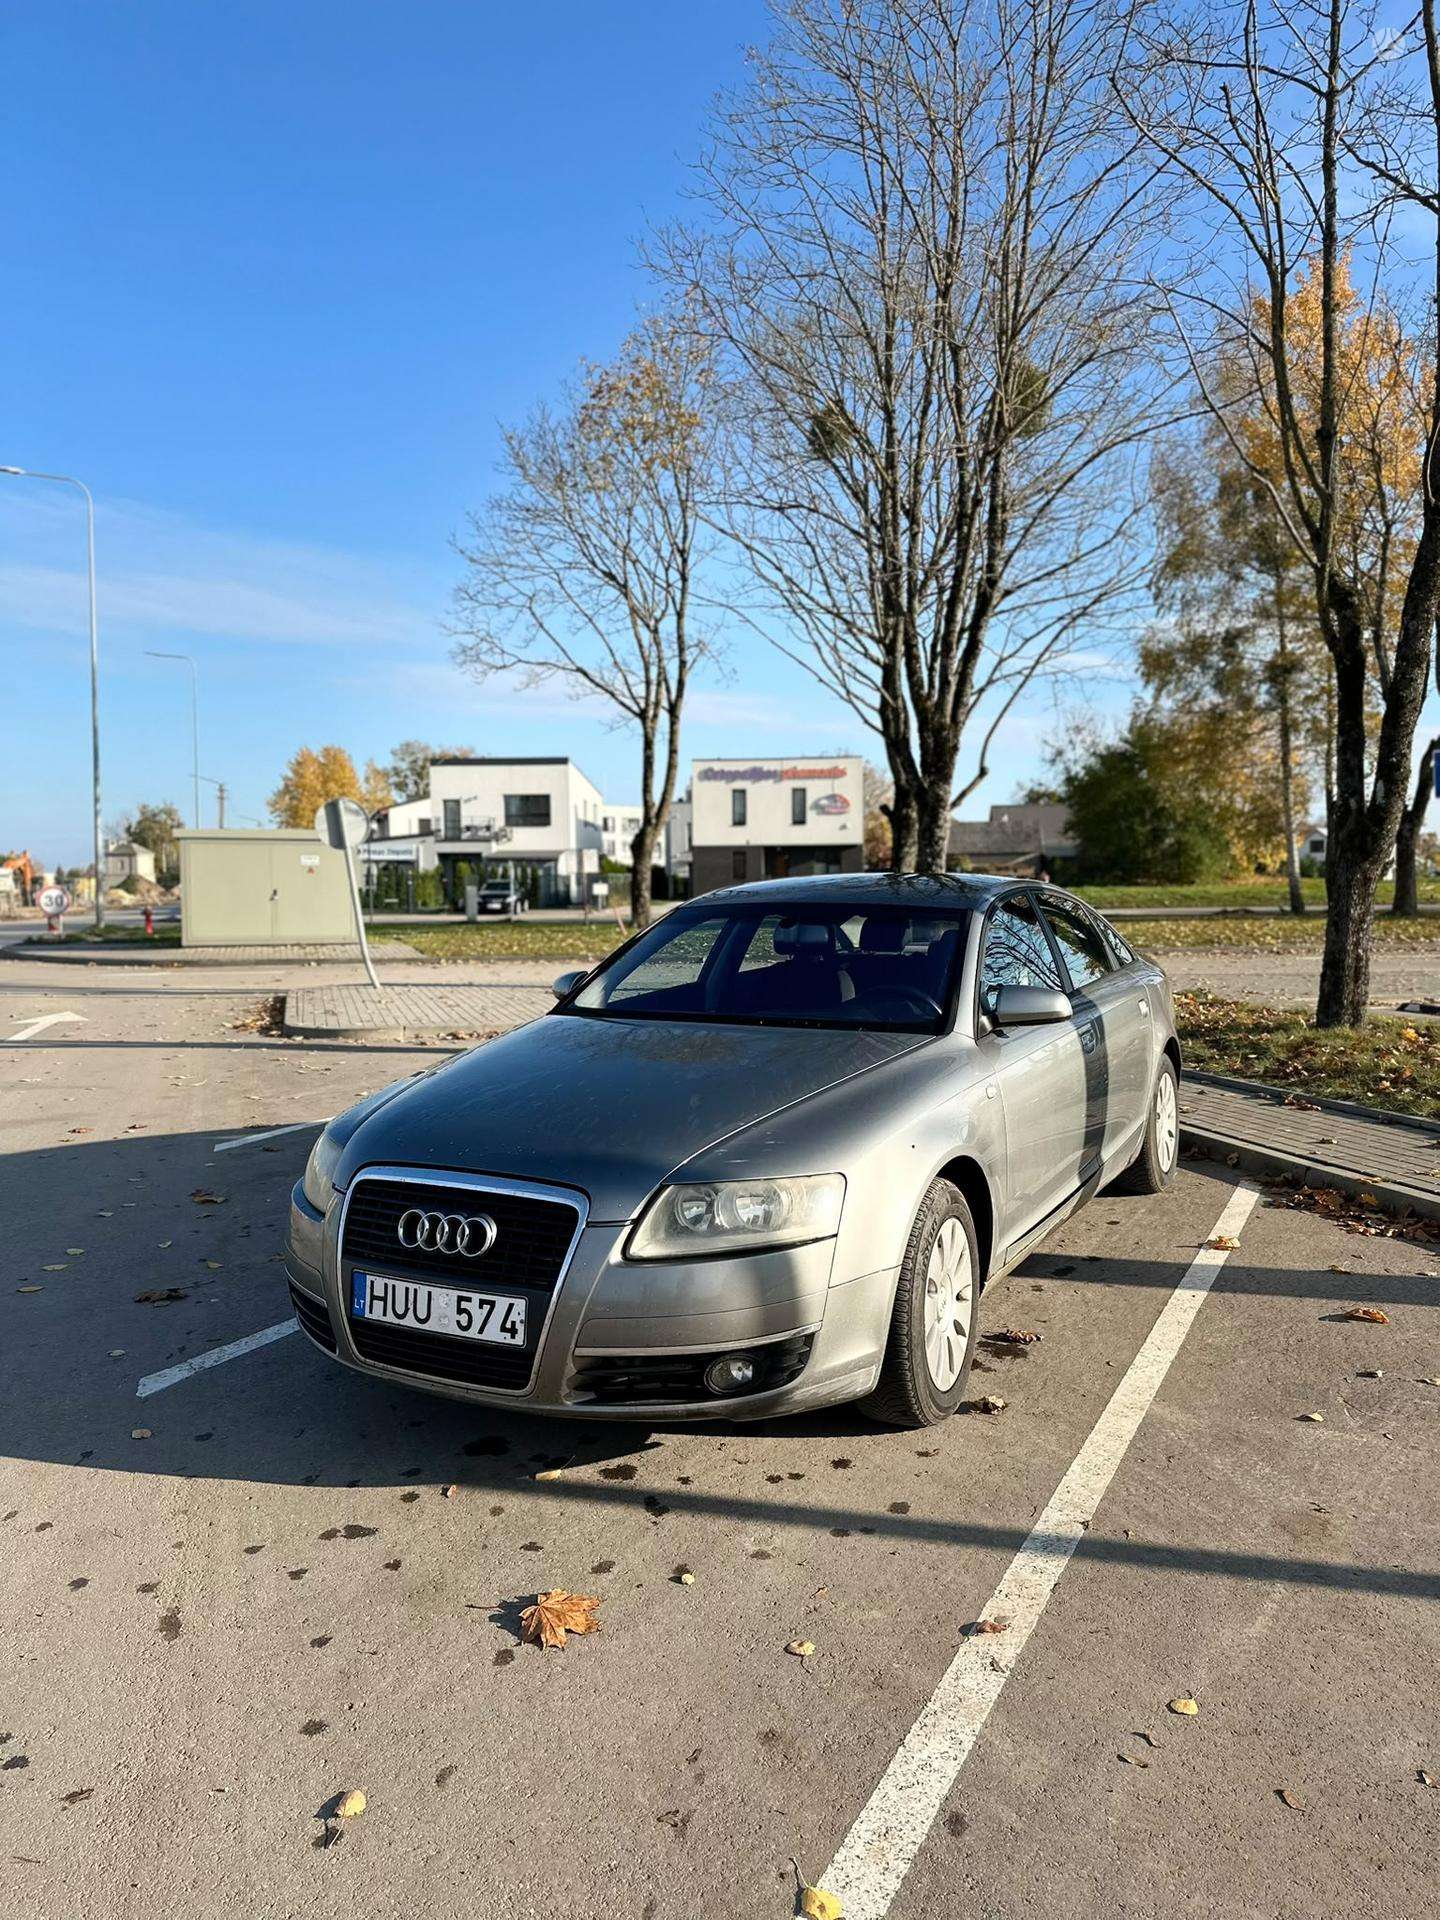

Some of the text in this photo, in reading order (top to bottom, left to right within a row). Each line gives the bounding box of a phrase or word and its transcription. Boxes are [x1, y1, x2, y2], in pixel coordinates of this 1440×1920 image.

[44, 895, 64, 907] 30
[354, 1298, 365, 1309] LT
[369, 1280, 518, 1340] HUU 574
